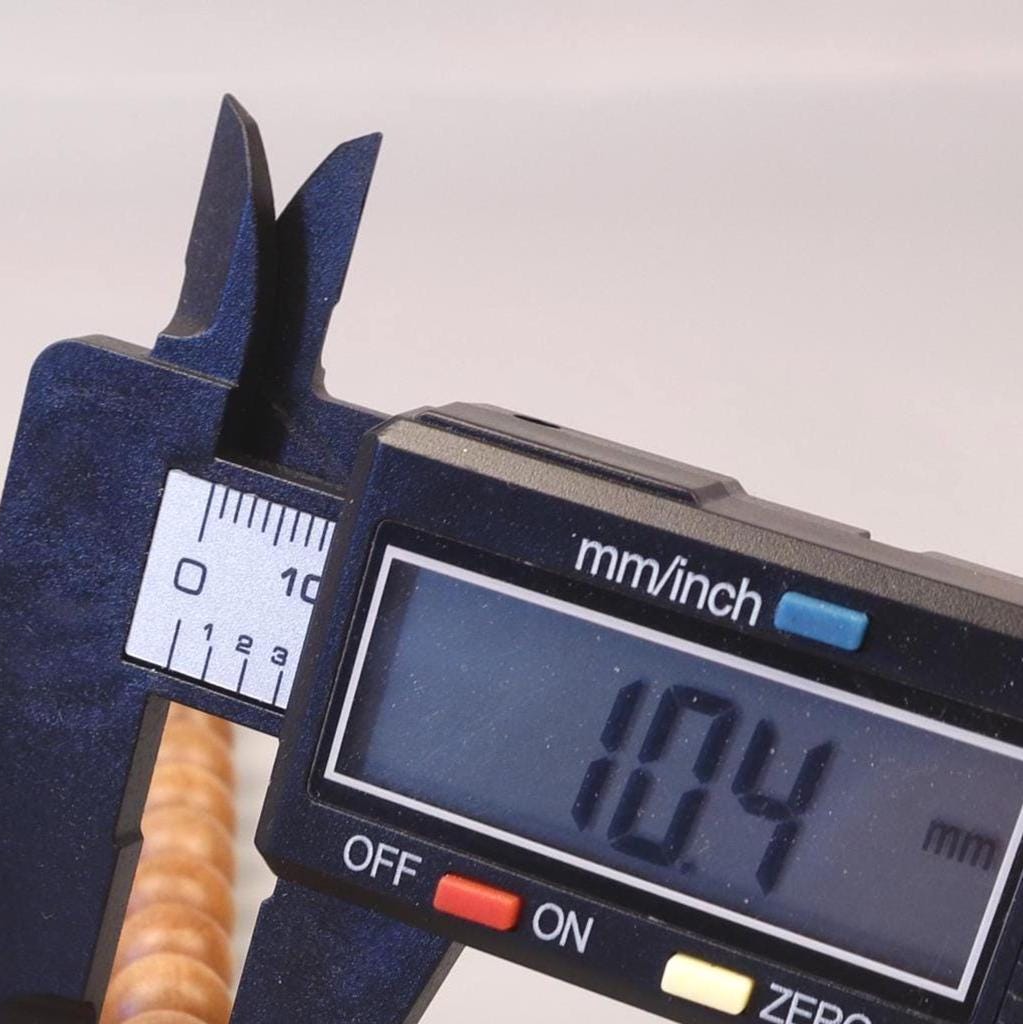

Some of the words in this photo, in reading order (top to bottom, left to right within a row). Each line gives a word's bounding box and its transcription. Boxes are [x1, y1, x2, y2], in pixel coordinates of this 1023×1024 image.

[173, 556, 208, 596] 0
[575, 535, 763, 627] mm/inch
[202, 622, 214, 642] 1
[234, 634, 254, 655] 2
[270, 646, 289, 667] 3
[572, 677, 835, 896] 10.4
[922, 816, 998, 872] mm
[342, 834, 423, 888] OFF
[531, 901, 595, 954] ON
